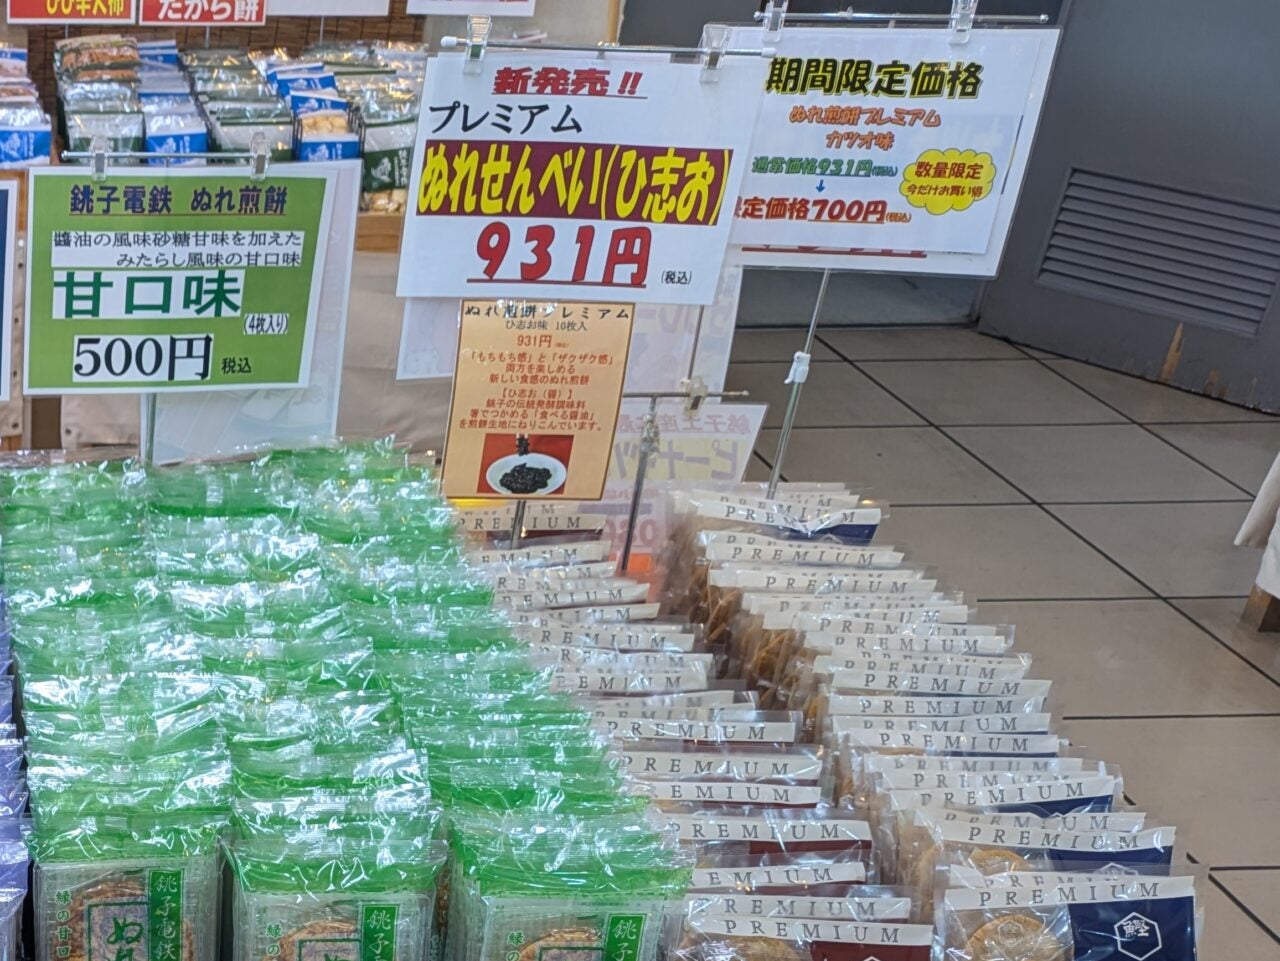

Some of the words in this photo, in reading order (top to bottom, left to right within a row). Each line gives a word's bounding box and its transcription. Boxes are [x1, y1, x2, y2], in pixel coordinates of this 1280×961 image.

[767, 59, 983, 97] 期間限定価格
[429, 101, 583, 135] プレミアム
[789, 106, 941, 127] ぬれ煎餅プレミアム
[825, 131, 895, 151] カツオ味
[915, 161, 983, 180] 数量限定
[418, 144, 731, 225] ぬれせんべい(ひ志お)
[906, 184, 983, 197] 今だけお買い得
[70, 184, 173, 214] 銚子電鉄
[191, 184, 288, 214] ぬれ煎餅
[116, 251, 300, 267] みたらし風味の甘口味
[476, 221, 652, 286] 931円
[660, 270, 693, 285] (税込)
[53, 269, 241, 318] 甘口味
[243, 313, 288, 335] (4枚入り)
[556, 321, 588, 332] 10枚入
[517, 334, 552, 348] 931円
[74, 334, 213, 381] 500円
[221, 357, 252, 374] 税込
[471, 352, 614, 365] 「もちもち感」と「ザクザク感」
[505, 363, 576, 374] 両方を楽しめる
[489, 374, 590, 386] 新しい食感のぬれ煎餅
[459, 516, 582, 529] PREIUM
[731, 547, 875, 565] PREMIUM
[766, 576, 908, 593] PREMIUM
[864, 673, 1021, 695] PREMIUM
[861, 699, 1013, 714] PREMIUM
[608, 721, 767, 740] PREMIUM
[880, 733, 1029, 751] PREMIUM
[670, 785, 791, 802] EMIUM
[968, 827, 1139, 849] PREMIUM
[979, 882, 1160, 907] PREMIUM
[154, 874, 177, 960] 銚子電鉄
[698, 897, 876, 917] PREMIUM
[725, 920, 902, 944] PREMIUM
